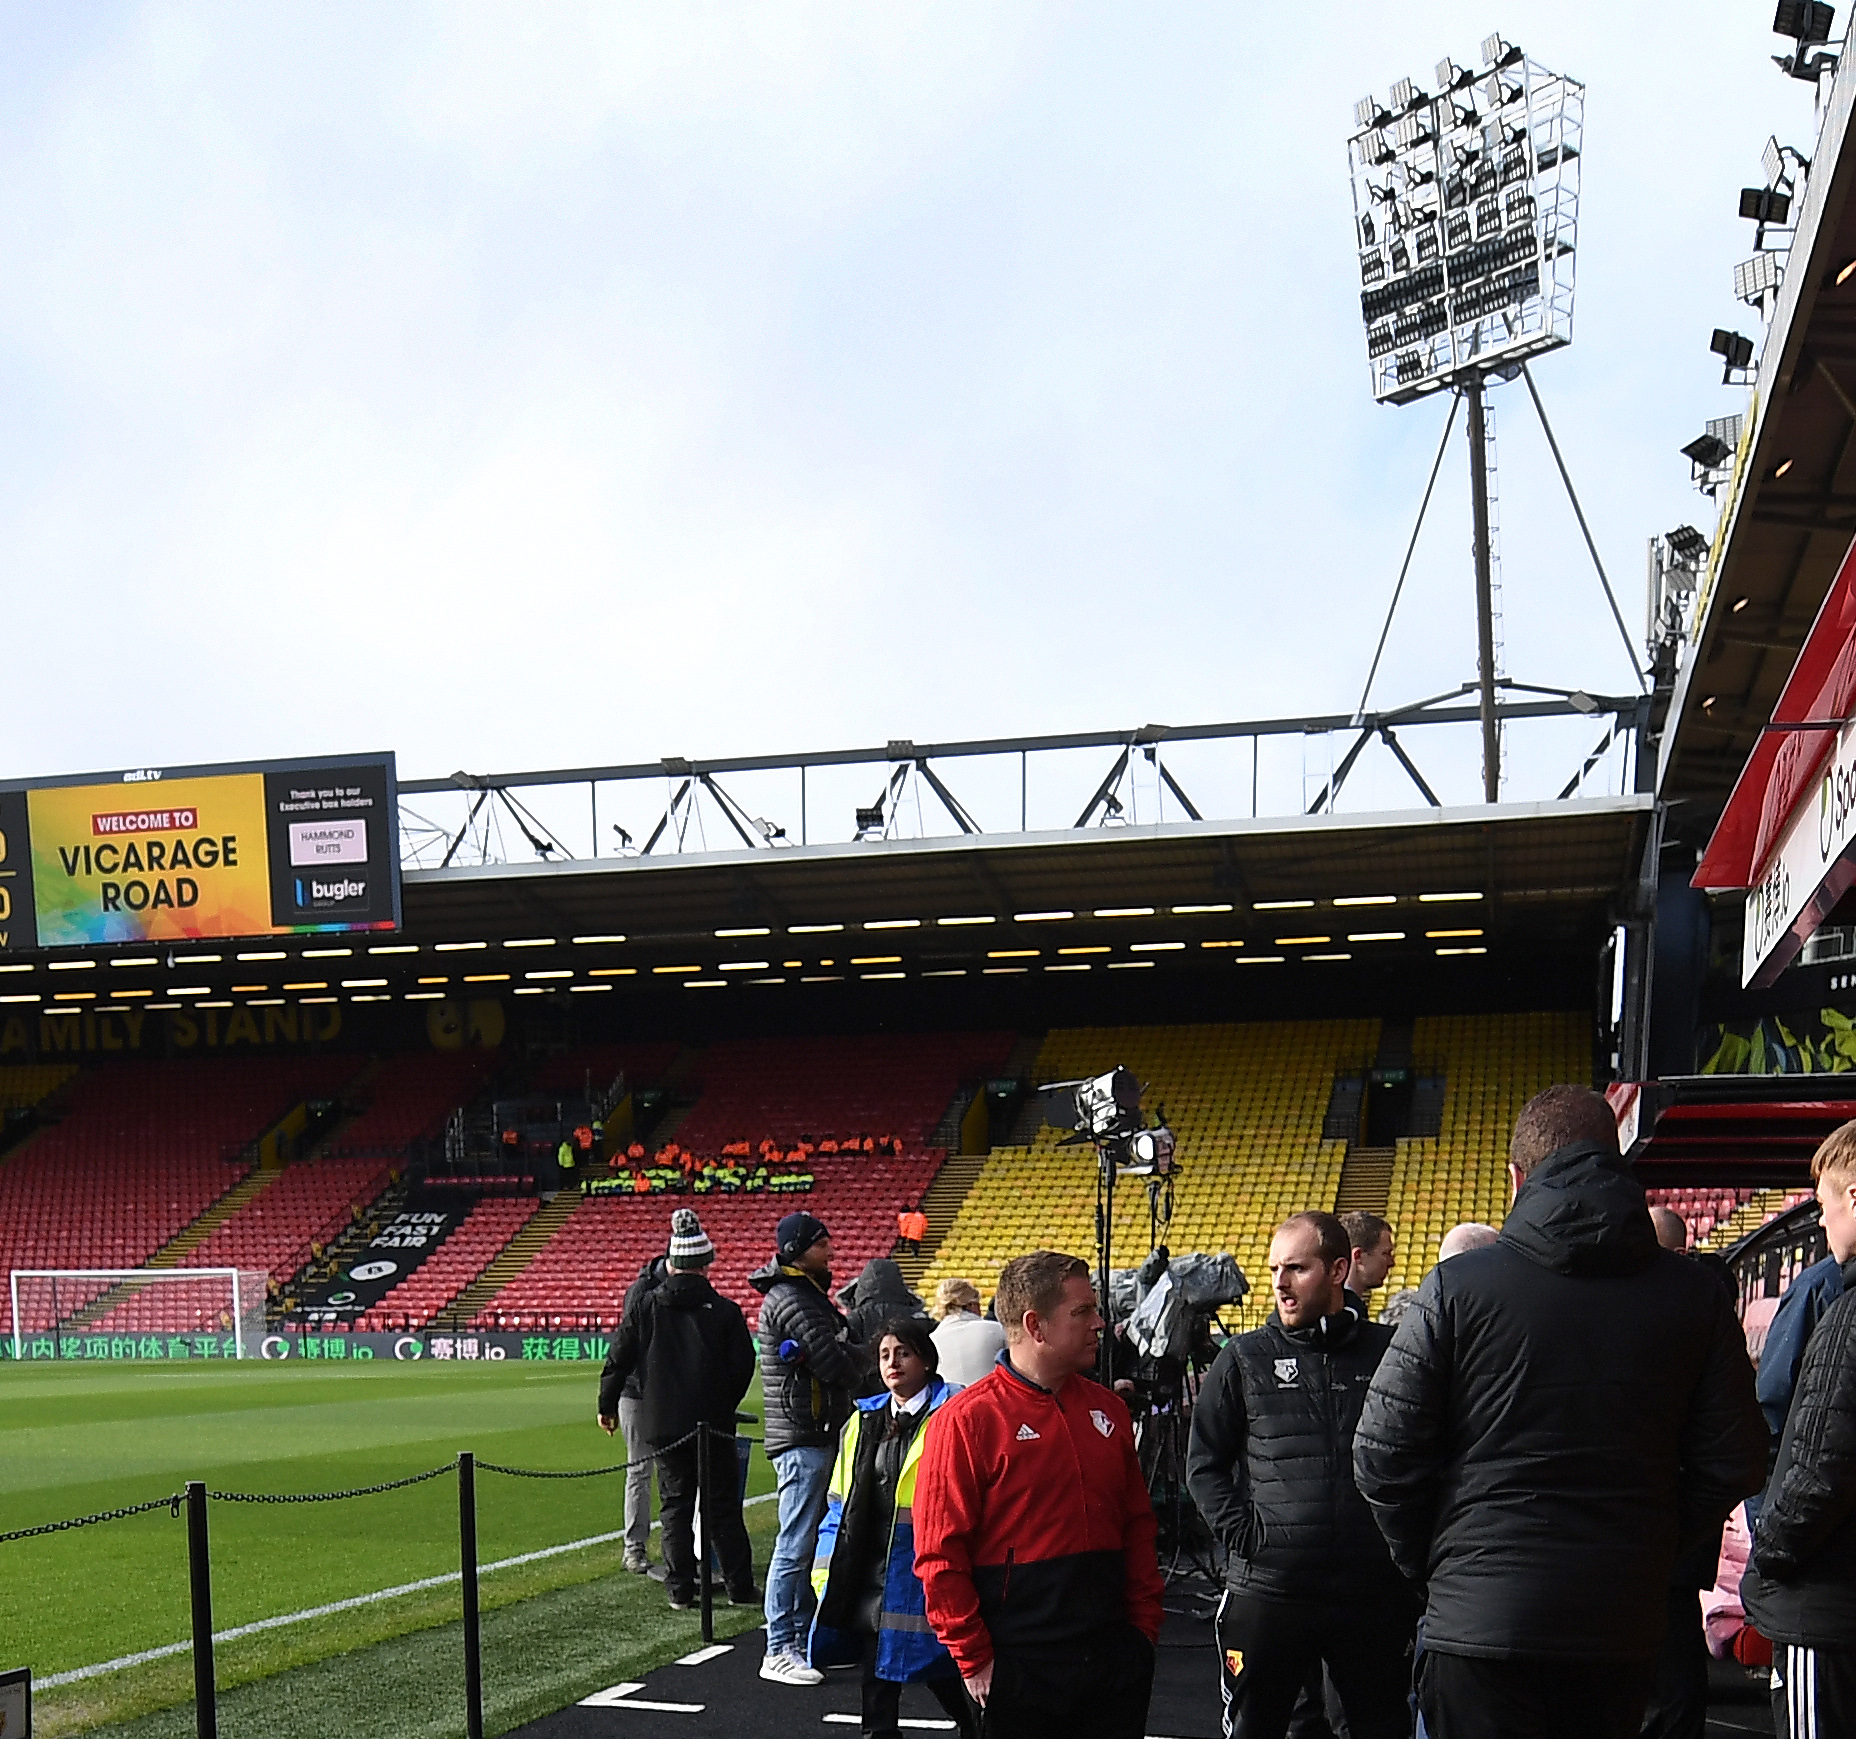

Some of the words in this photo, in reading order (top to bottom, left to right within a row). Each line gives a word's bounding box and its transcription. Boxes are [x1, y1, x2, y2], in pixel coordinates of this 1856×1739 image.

[318, 789, 334, 799] you
[346, 786, 361, 795] our
[322, 800, 339, 809] box
[341, 798, 373, 807] holders
[96, 815, 170, 832] WELCOME
[173, 811, 194, 827] TO
[58, 835, 238, 876] VICARAGE
[101, 877, 199, 912] ROAD
[311, 879, 366, 900] bugler
[394, 1213, 447, 1224] FUN
[382, 1225, 440, 1236] FAST
[369, 1236, 428, 1248] FAIR
